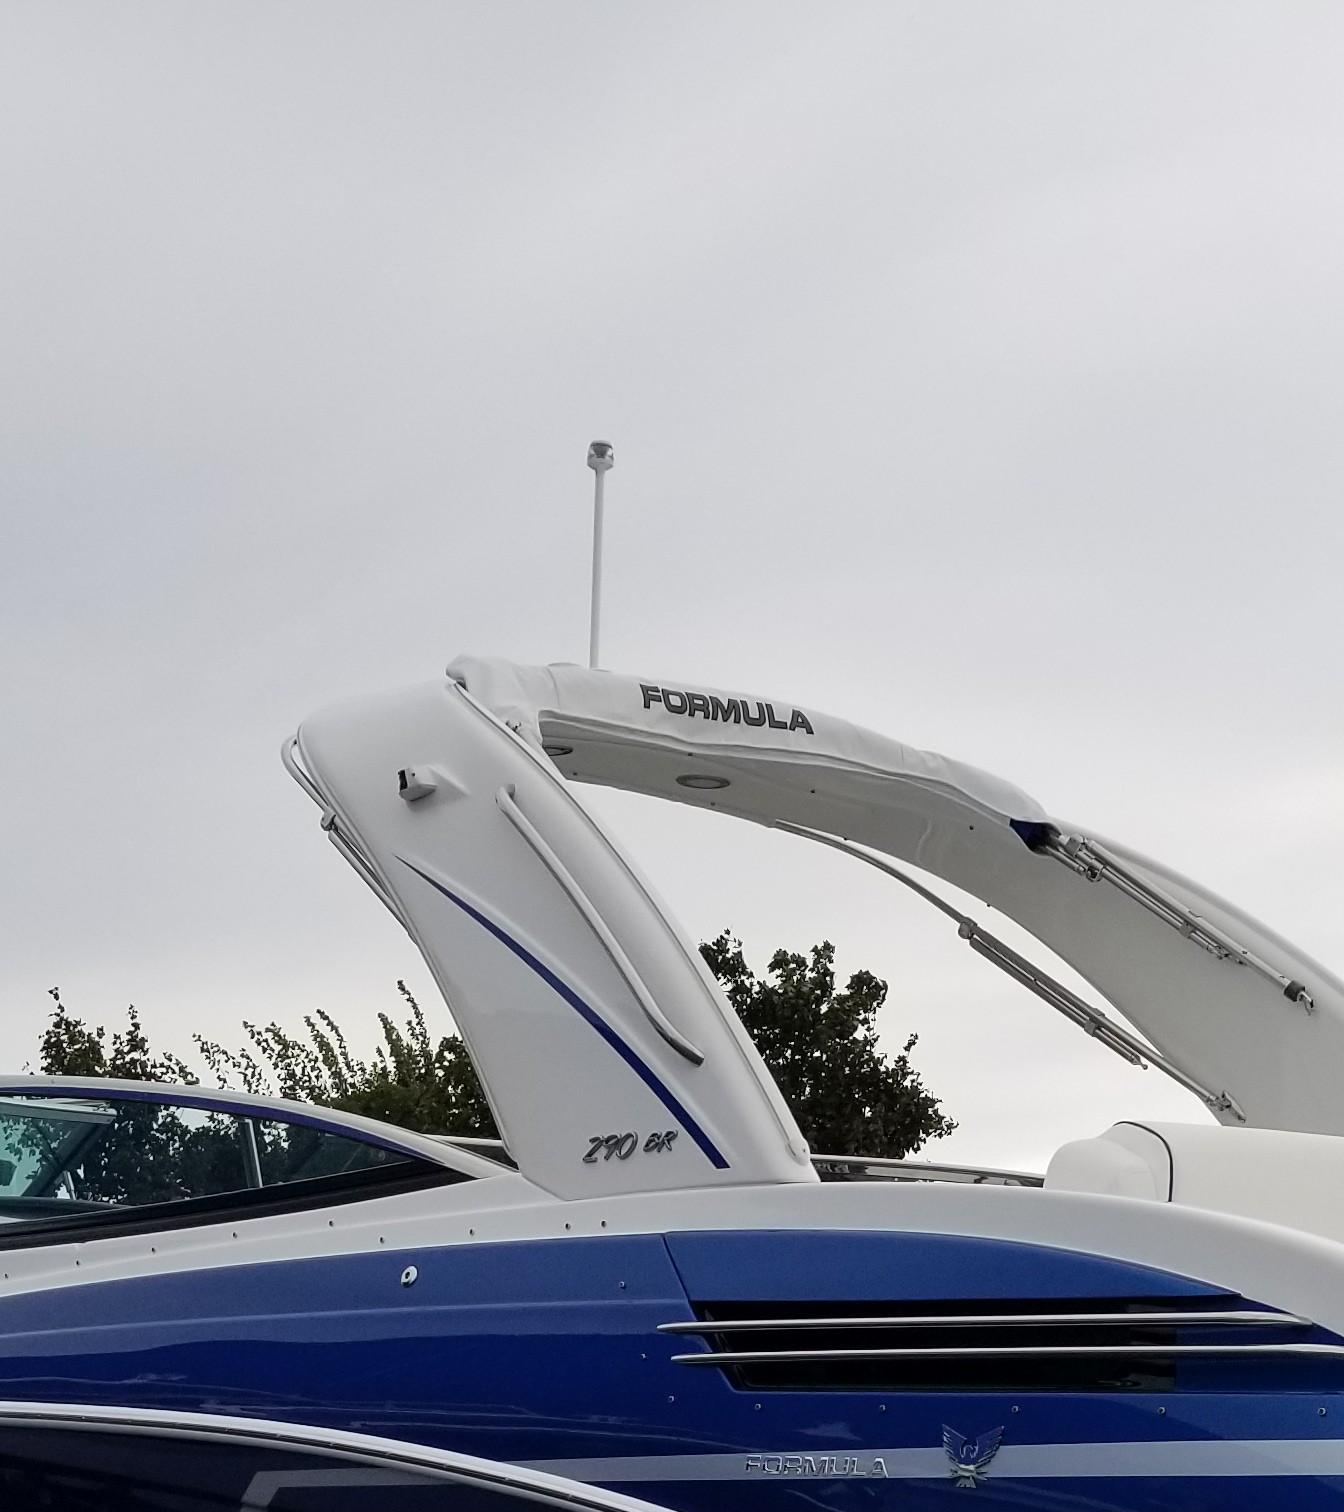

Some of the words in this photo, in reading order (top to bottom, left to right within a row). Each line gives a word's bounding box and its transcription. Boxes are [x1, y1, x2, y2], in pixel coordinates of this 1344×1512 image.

[639, 683, 814, 735] FORMULA
[582, 1131, 638, 1163] 290
[745, 1453, 890, 1479] FORMULA
